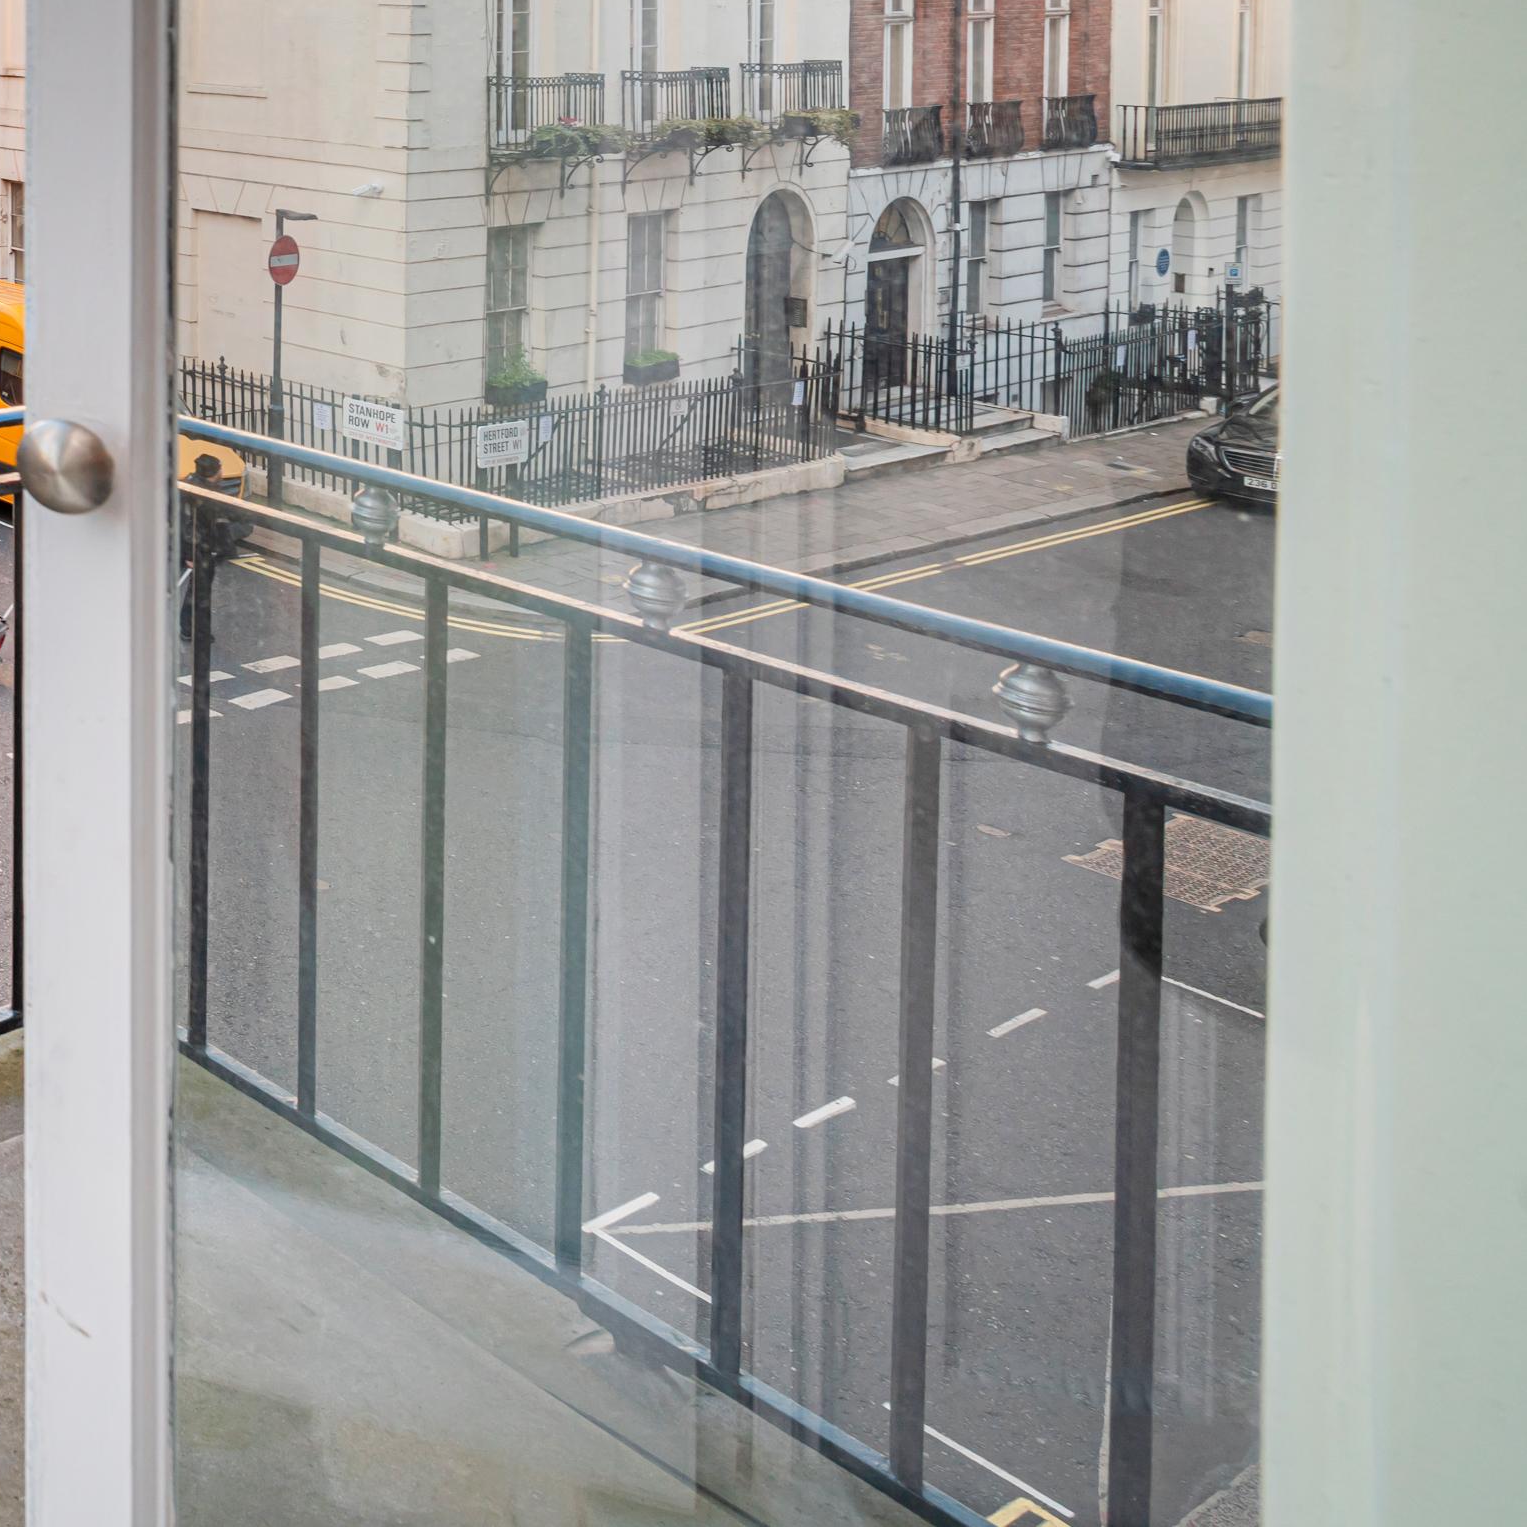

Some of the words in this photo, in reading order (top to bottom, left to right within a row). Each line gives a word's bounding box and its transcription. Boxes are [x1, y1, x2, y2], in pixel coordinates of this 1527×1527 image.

[348, 403, 396, 423] STANHOPE
[348, 415, 370, 429] ROW
[375, 422, 389, 434] W1
[483, 427, 519, 442] HERTFORD
[483, 441, 509, 454] STREET
[512, 439, 522, 450] W1
